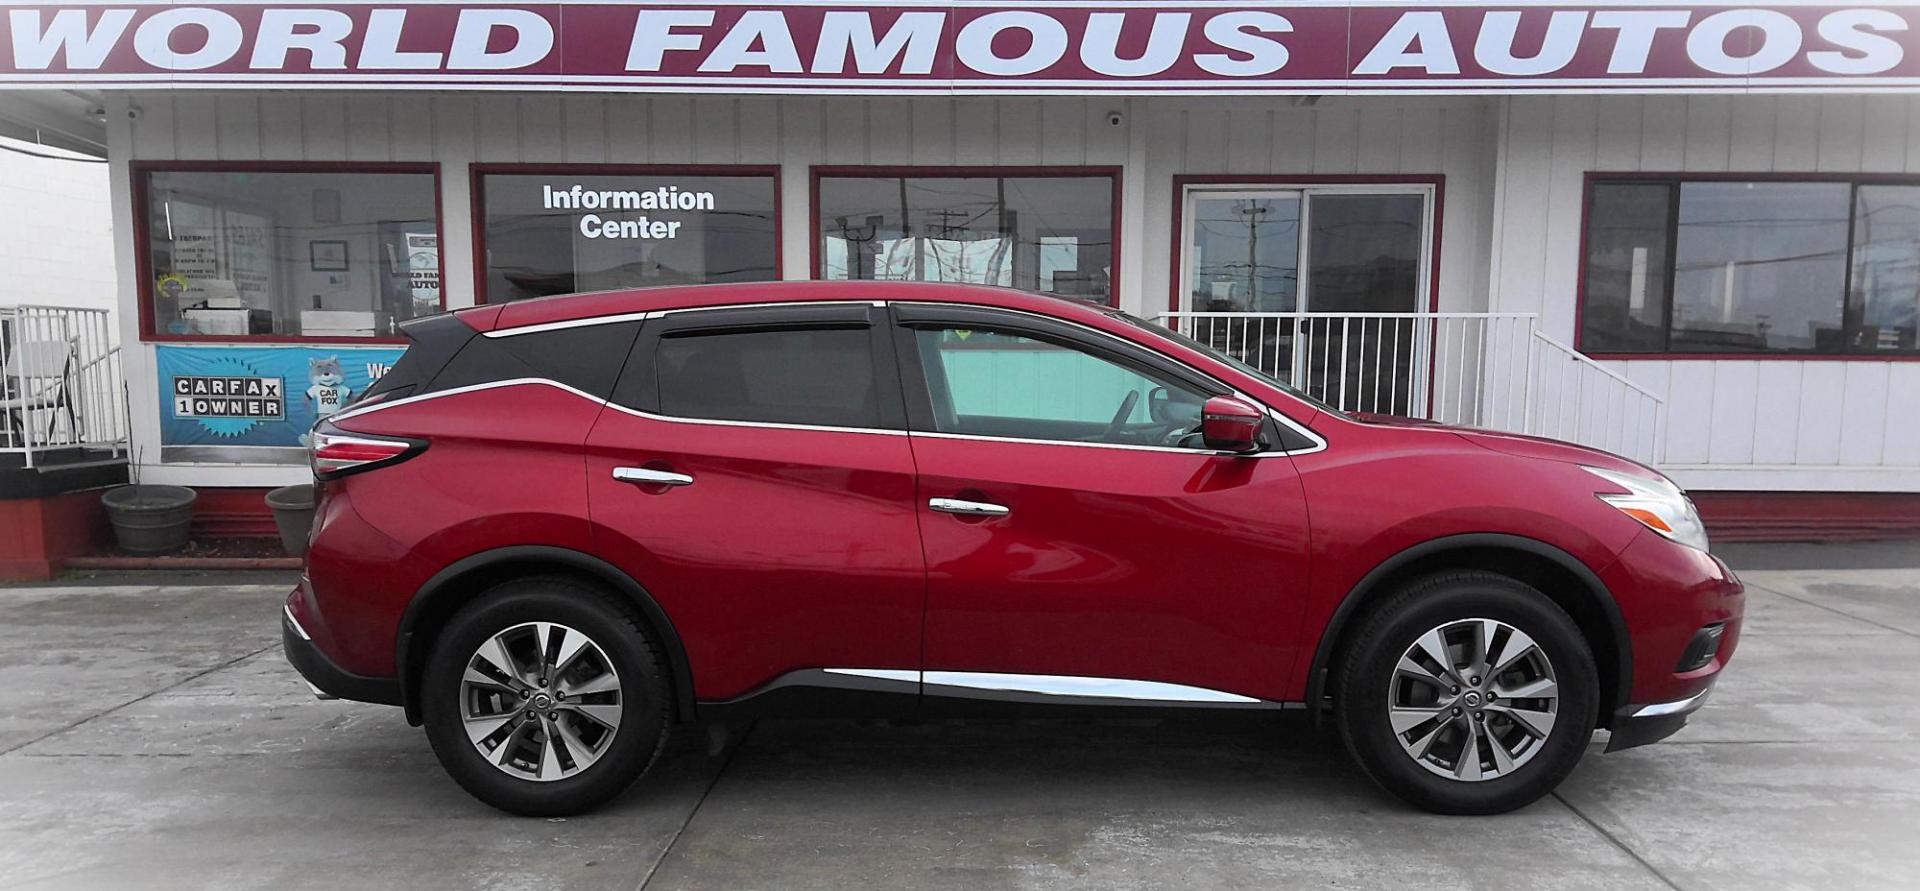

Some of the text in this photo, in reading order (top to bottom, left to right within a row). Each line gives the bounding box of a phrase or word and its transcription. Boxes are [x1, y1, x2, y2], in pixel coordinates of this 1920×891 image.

[9, 8, 1909, 76] WORLD FAMOUS AUTOS
[543, 185, 714, 210] Information
[580, 214, 681, 239] Center
[177, 379, 277, 397] CARFAX
[320, 389, 337, 397] CAR
[180, 401, 279, 415] 1 OWNER
[321, 397, 337, 405] FOX
